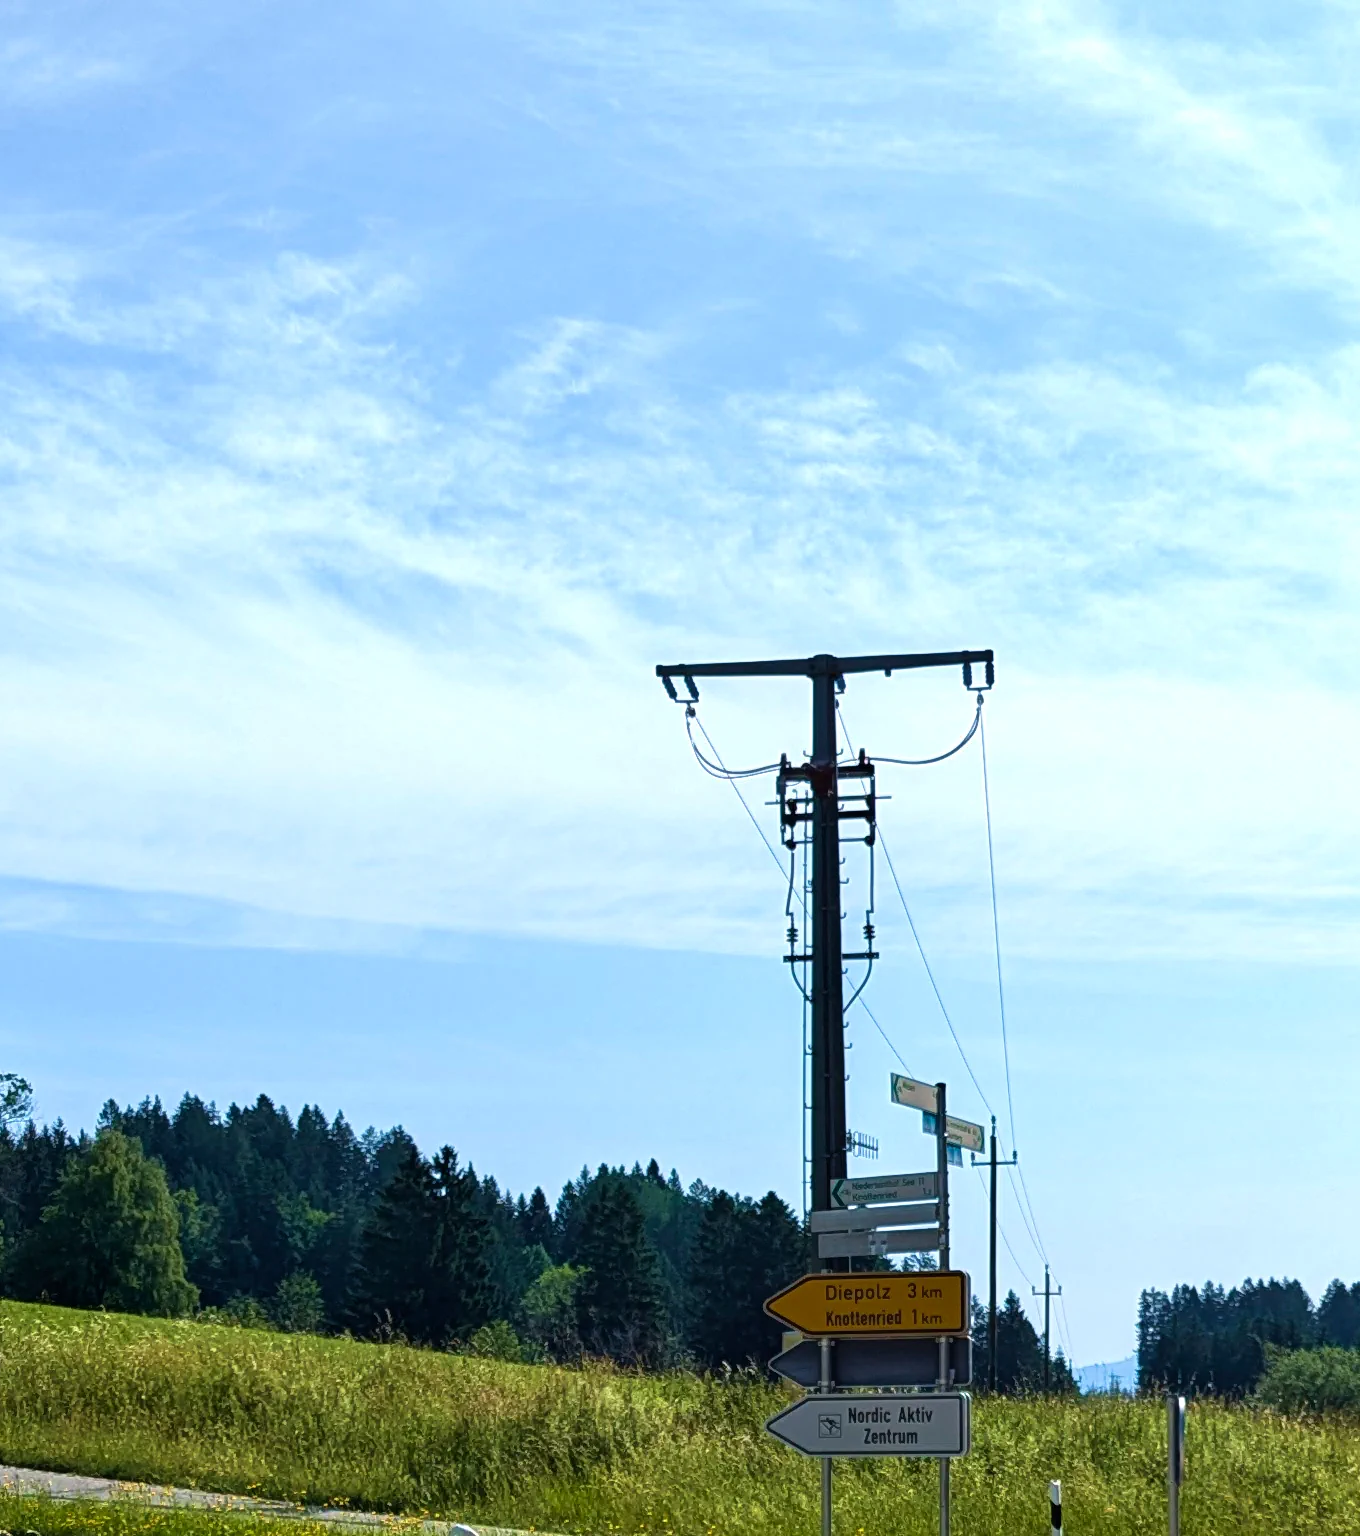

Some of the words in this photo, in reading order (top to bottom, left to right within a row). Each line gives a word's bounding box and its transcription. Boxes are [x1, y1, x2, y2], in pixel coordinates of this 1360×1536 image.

[825, 1284, 892, 1305] Diepolz
[908, 1282, 917, 1299] 3
[921, 1286, 943, 1299] km
[825, 1308, 902, 1327] Knottenried
[912, 1308, 918, 1325] 1
[921, 1312, 943, 1325] km
[848, 1406, 892, 1424] Nordic
[898, 1406, 933, 1424] Aktiv
[863, 1428, 918, 1445] Zentrum
